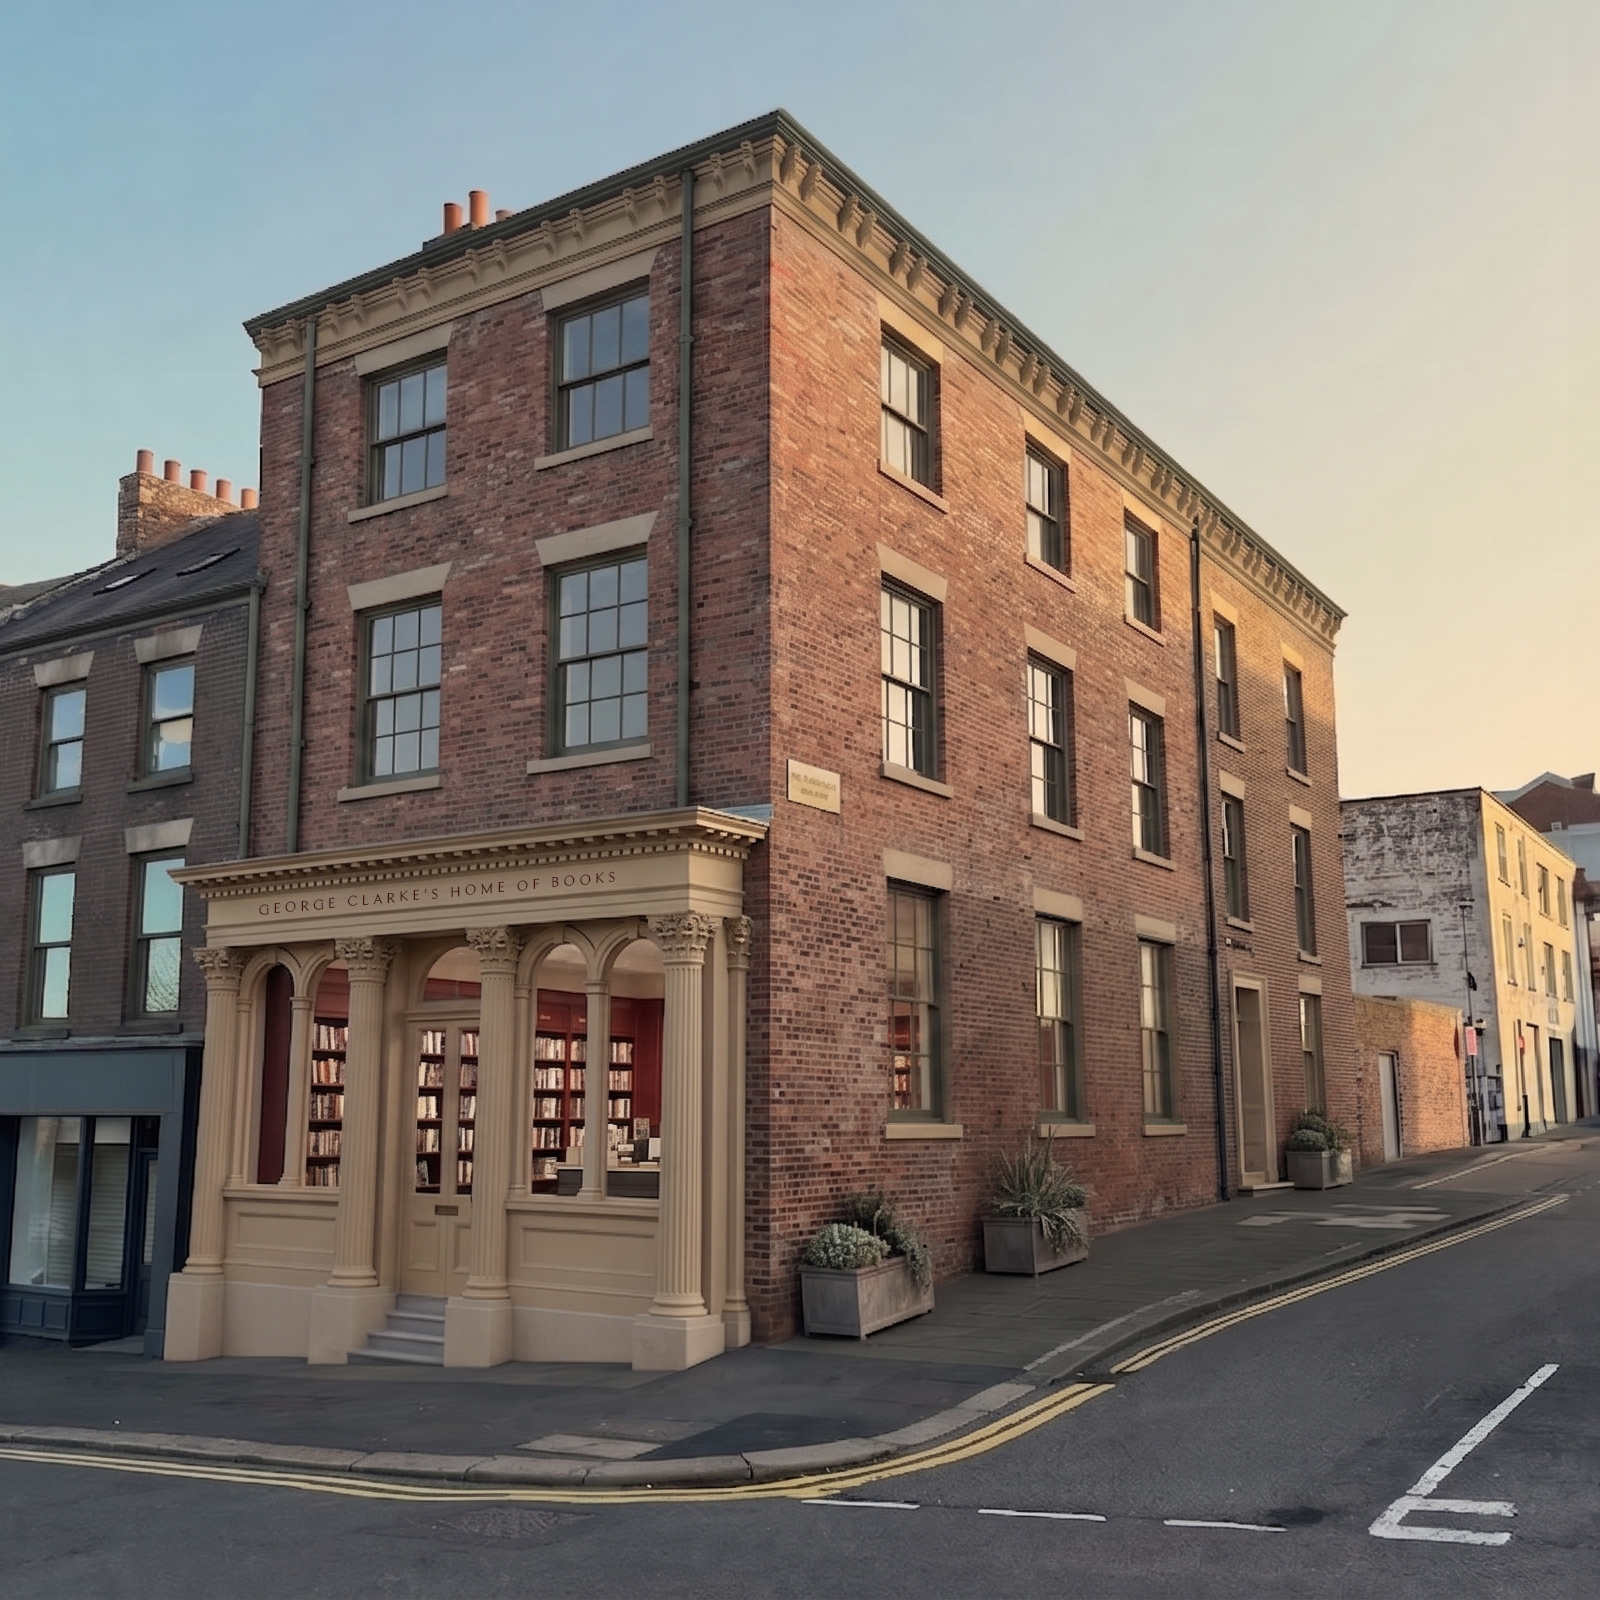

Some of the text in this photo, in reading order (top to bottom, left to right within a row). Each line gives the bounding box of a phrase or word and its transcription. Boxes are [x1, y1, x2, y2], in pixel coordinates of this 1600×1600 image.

[259, 871, 616, 915] GEORGE CLARKE'S HOME OF BOOKS
